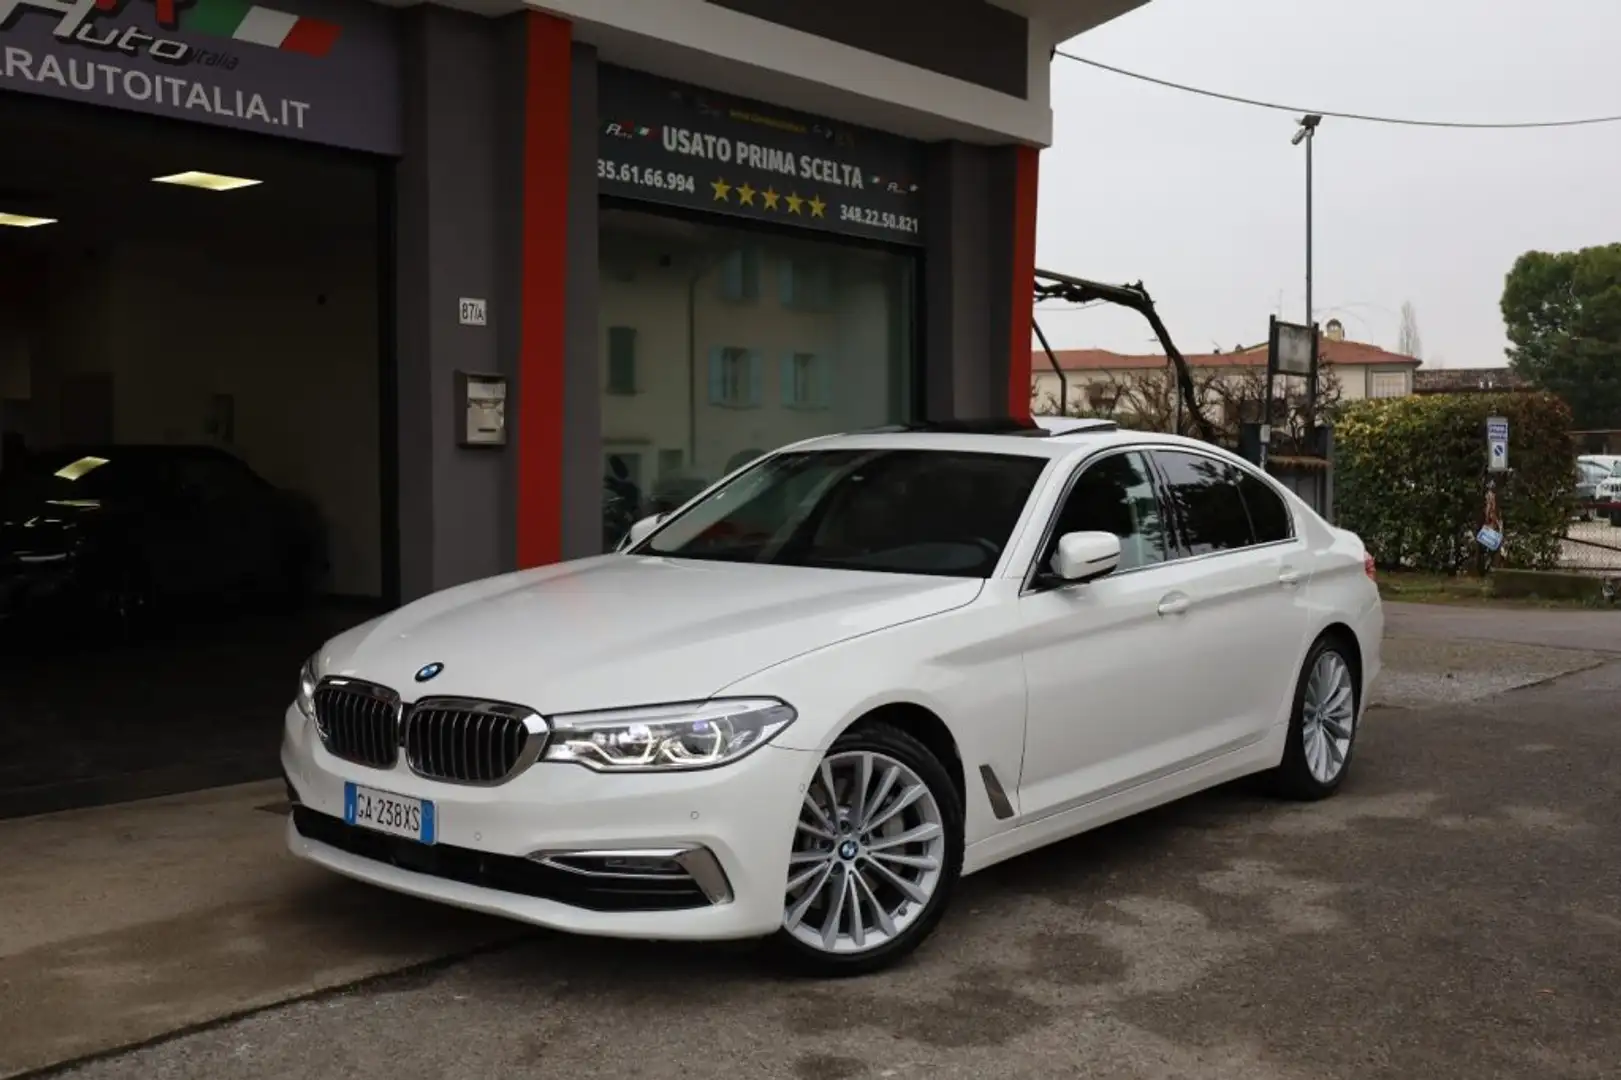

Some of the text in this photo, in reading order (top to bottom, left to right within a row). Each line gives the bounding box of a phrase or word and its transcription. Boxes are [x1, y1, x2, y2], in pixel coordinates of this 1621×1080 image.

[0, 46, 310, 128] RAUTOITALIA.IT
[662, 125, 731, 162] USATO
[736, 141, 796, 176] PRIMA
[800, 155, 864, 189] SCELTA
[840, 204, 919, 234] 348.22.50.821
